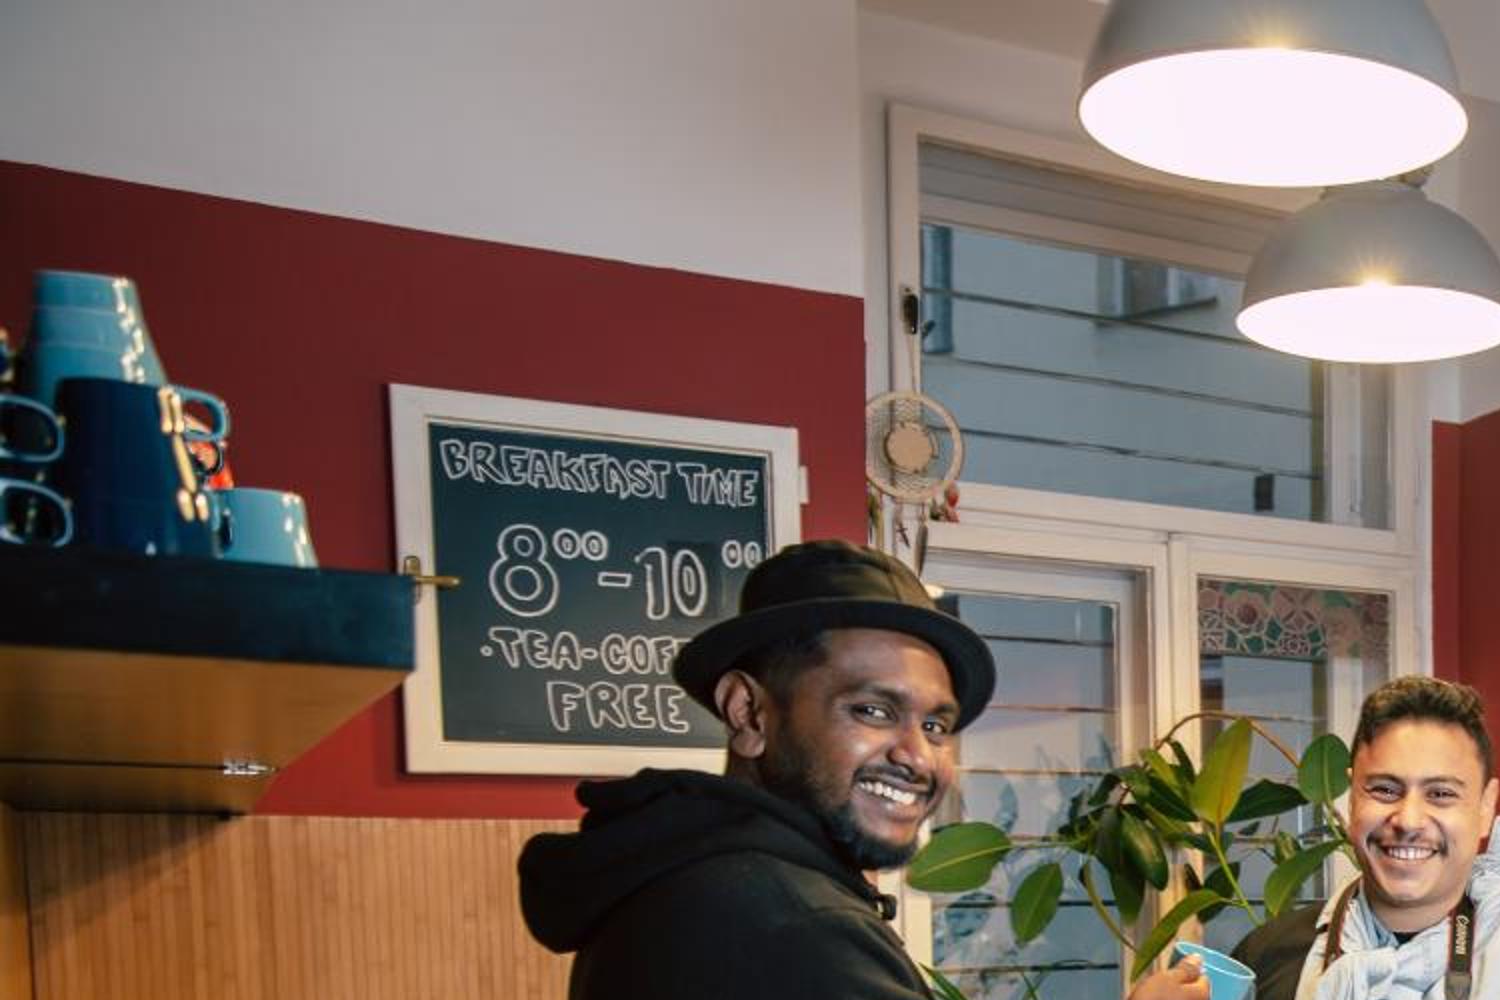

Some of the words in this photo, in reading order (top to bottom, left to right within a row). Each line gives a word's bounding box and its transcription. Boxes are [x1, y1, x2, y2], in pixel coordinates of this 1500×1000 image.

[439, 438, 671, 499] BREAKFAST
[675, 462, 759, 508] TIME
[547, 681, 690, 732] FREE
